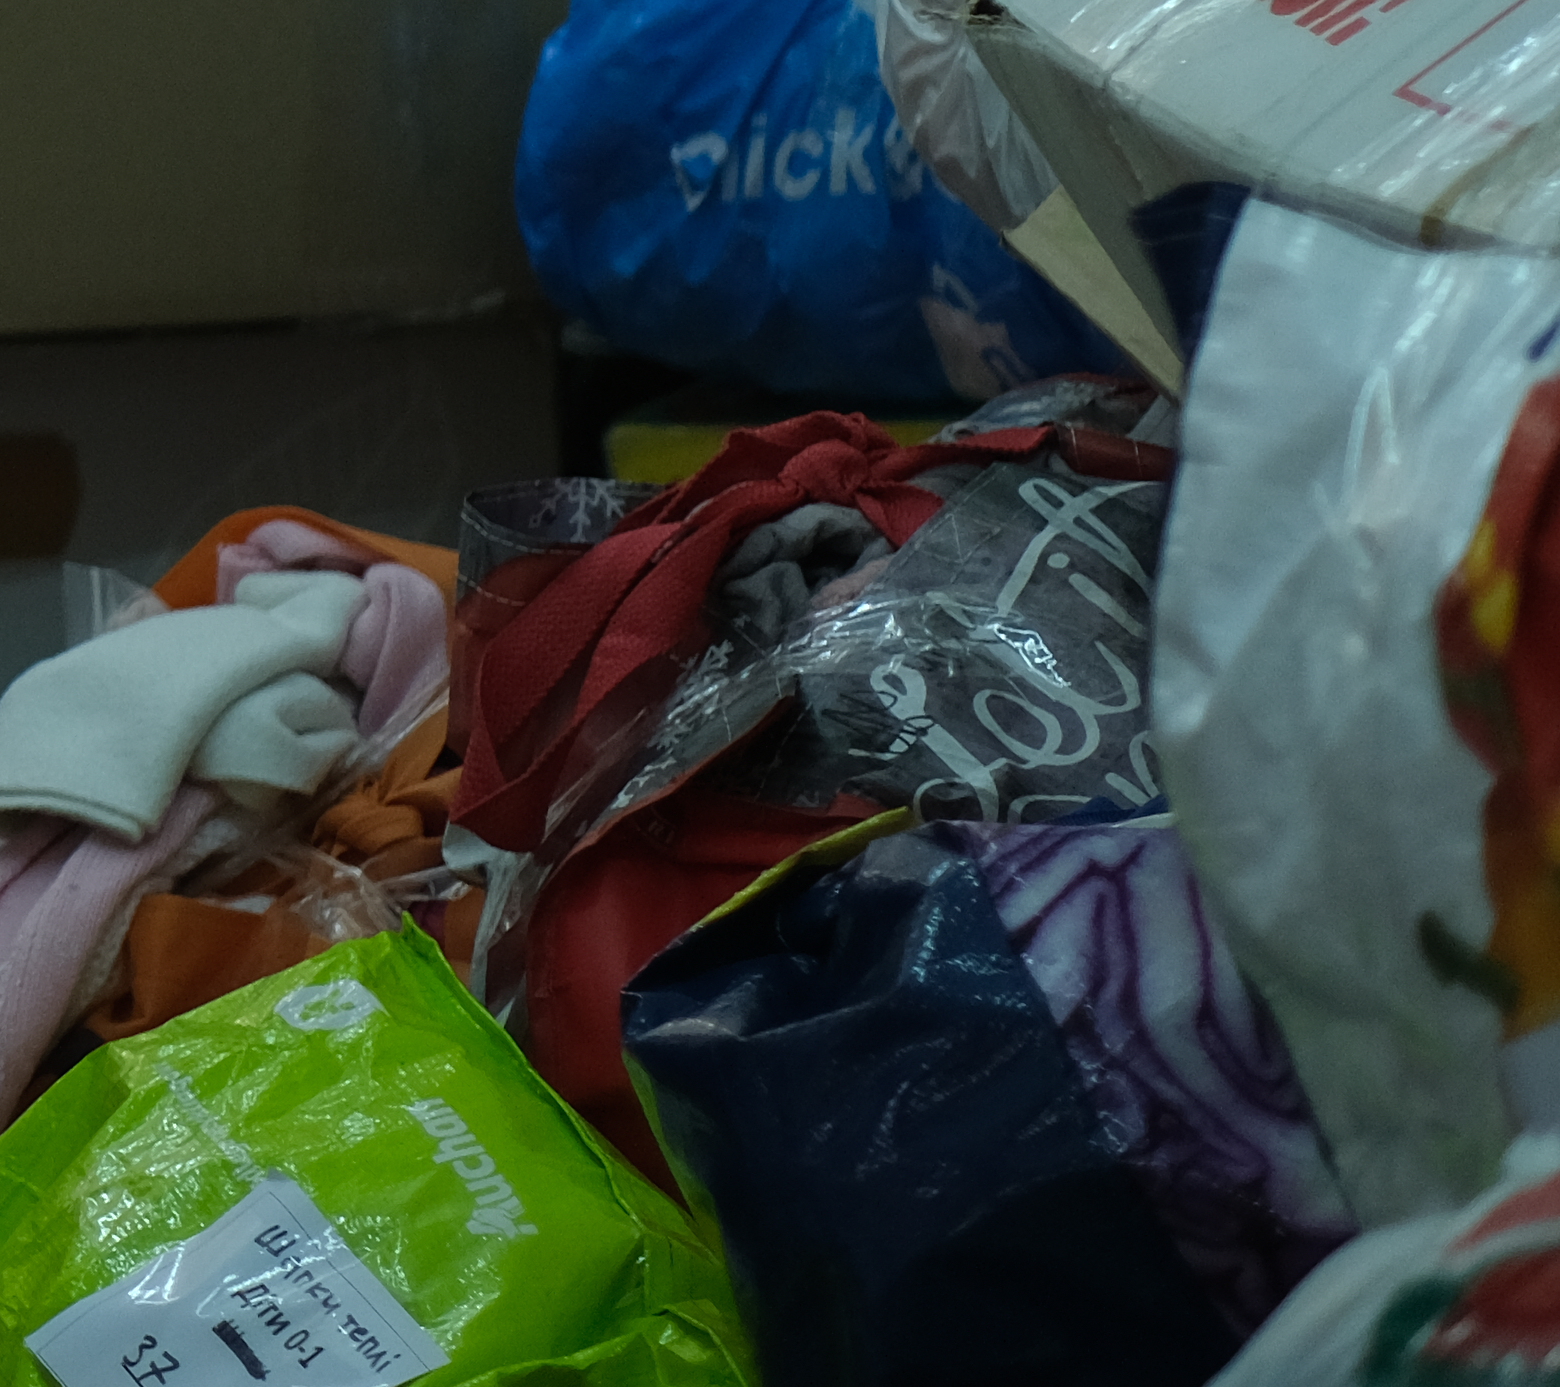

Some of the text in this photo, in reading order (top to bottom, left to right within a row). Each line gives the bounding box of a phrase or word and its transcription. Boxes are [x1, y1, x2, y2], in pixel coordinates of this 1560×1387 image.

[406, 1097, 539, 1239] Auchan
[123, 1335, 180, 1385] 37
[231, 1283, 325, 1369] Діти 0-1
